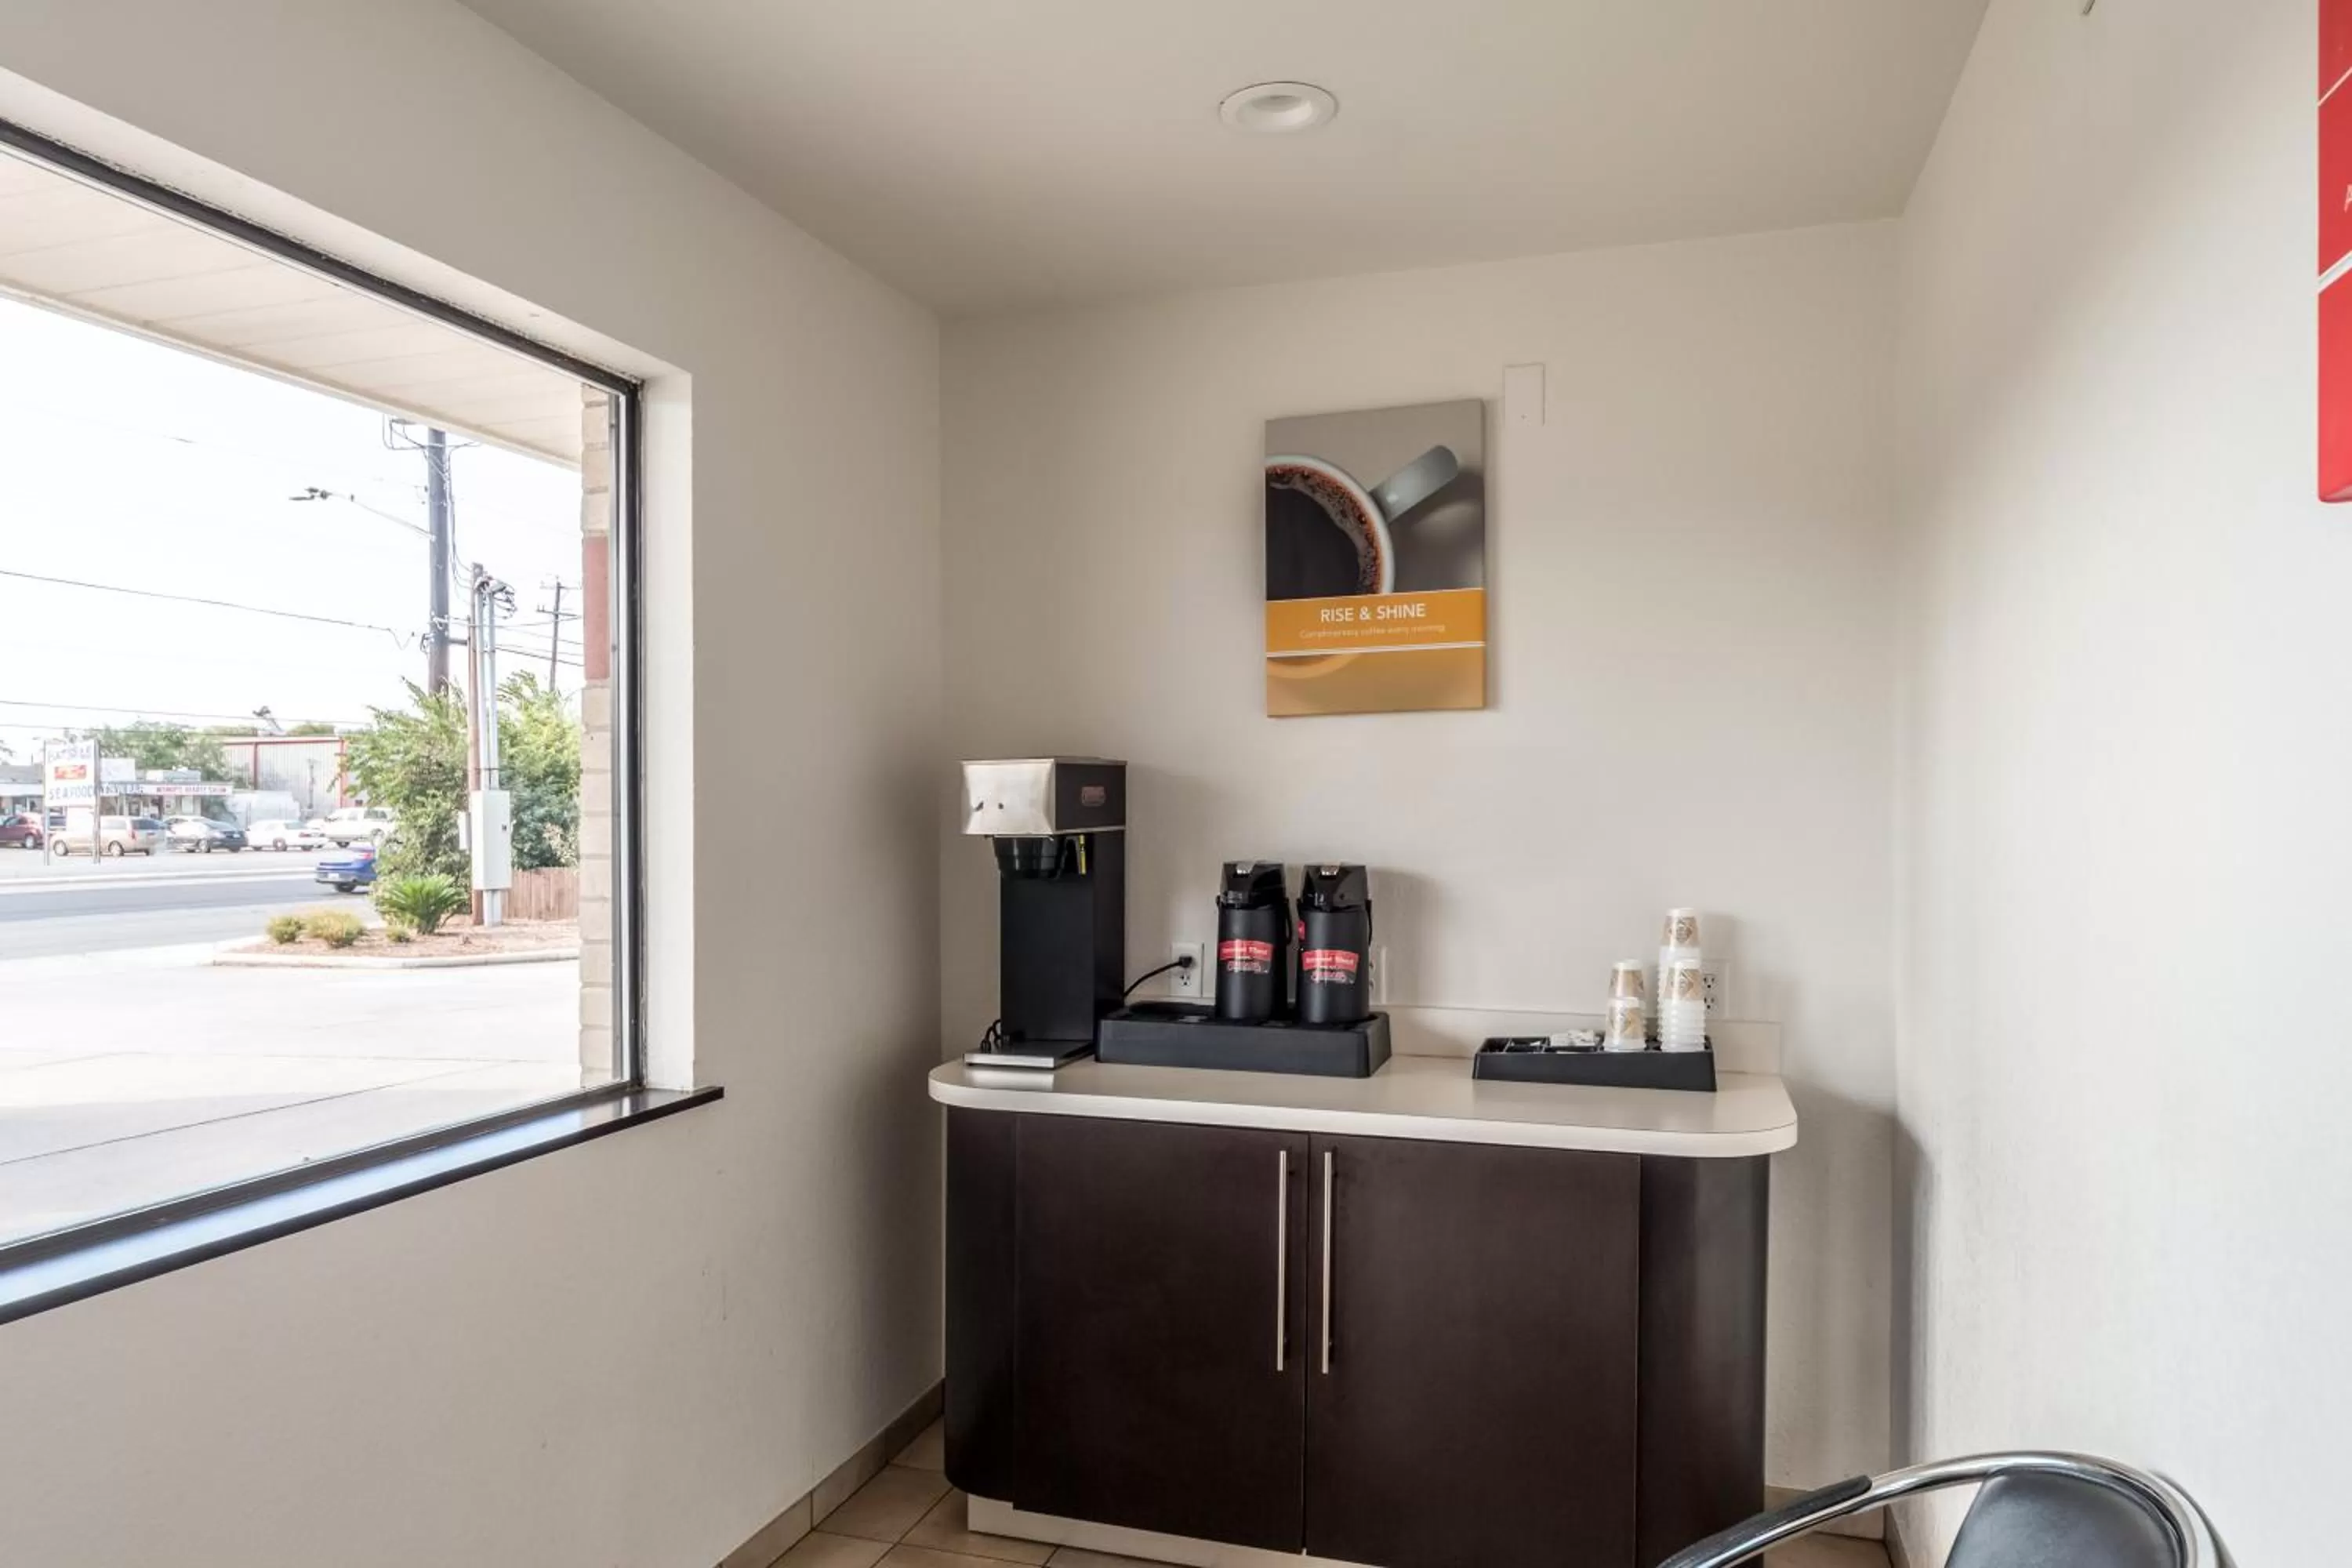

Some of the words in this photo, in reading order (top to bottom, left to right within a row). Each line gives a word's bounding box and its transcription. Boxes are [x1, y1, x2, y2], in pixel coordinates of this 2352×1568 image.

[1320, 607, 1355, 622] RISE
[1359, 605, 1372, 621] &
[1376, 603, 1426, 619] SHINE
[1360, 626, 1385, 637] coffee
